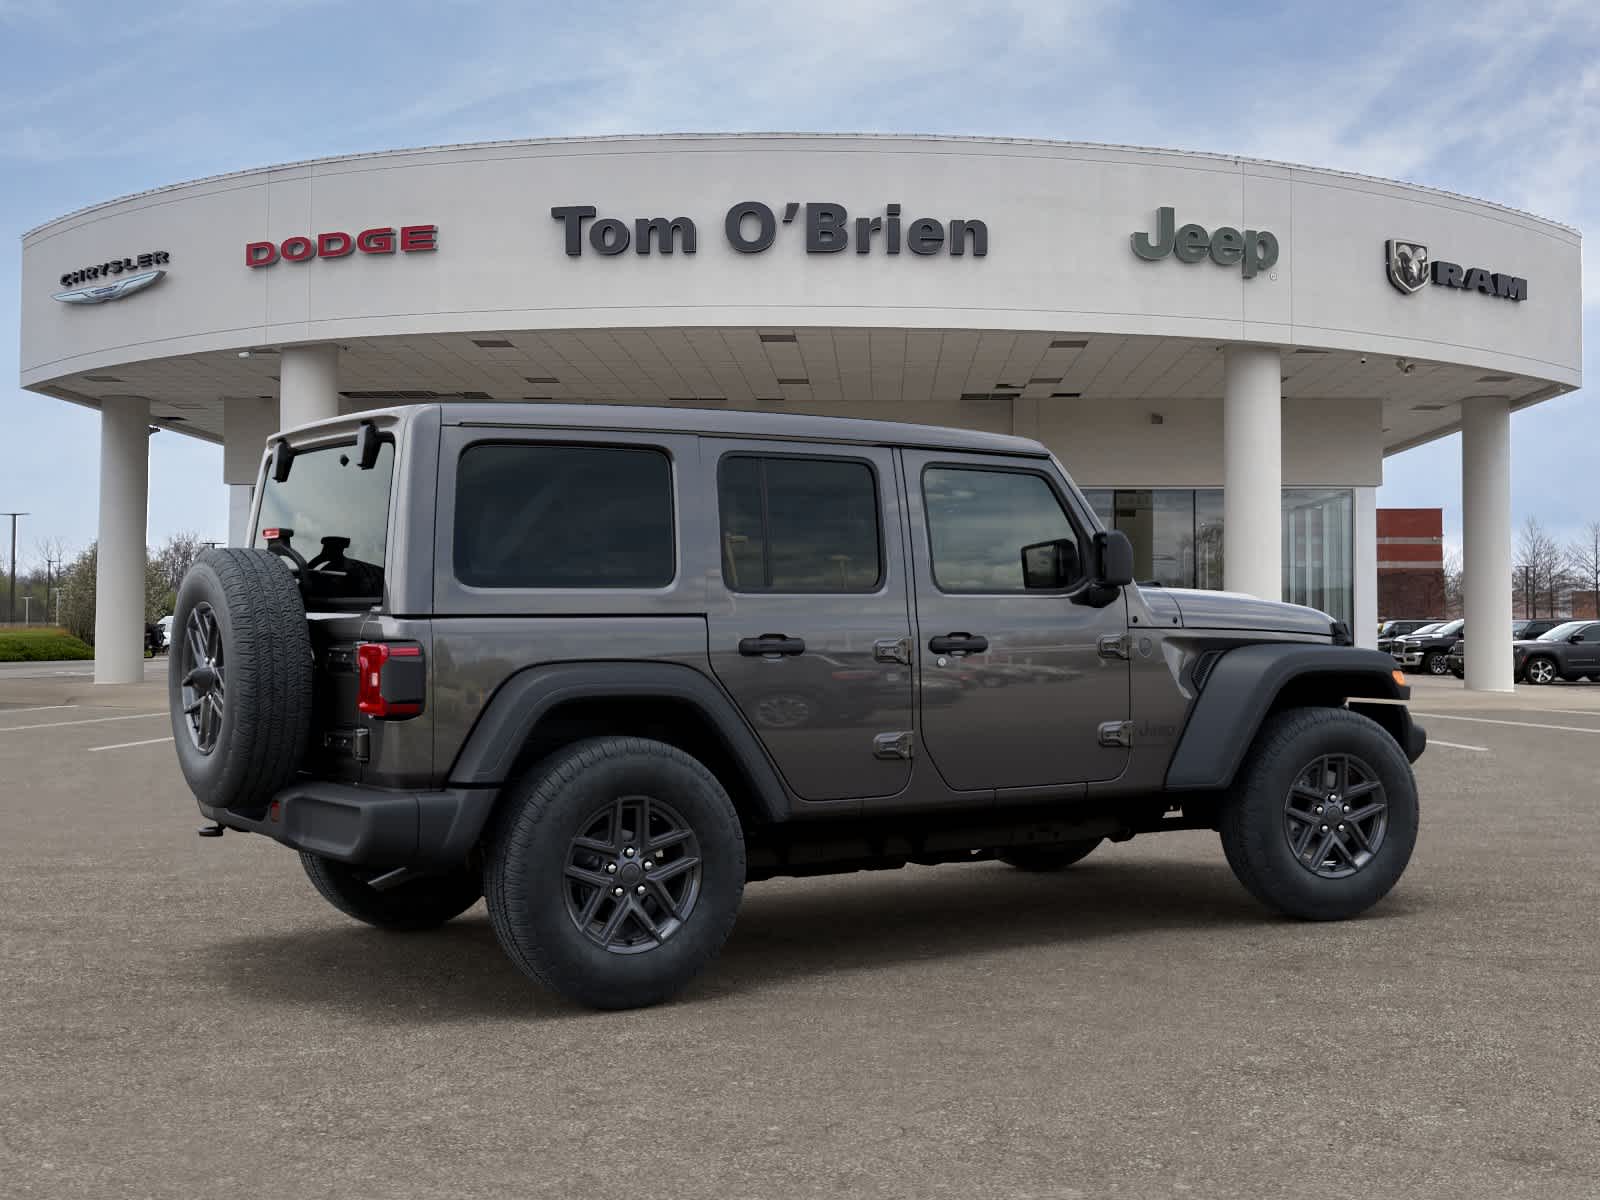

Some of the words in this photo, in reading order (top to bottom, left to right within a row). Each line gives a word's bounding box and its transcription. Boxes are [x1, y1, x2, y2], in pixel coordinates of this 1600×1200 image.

[245, 225, 437, 268] DODGE
[551, 205, 696, 256] Tom
[724, 201, 988, 257] O'Brien
[1130, 206, 1279, 280] Jeep
[60, 250, 170, 287] CHRYSLER
[1431, 261, 1528, 302] RAM
